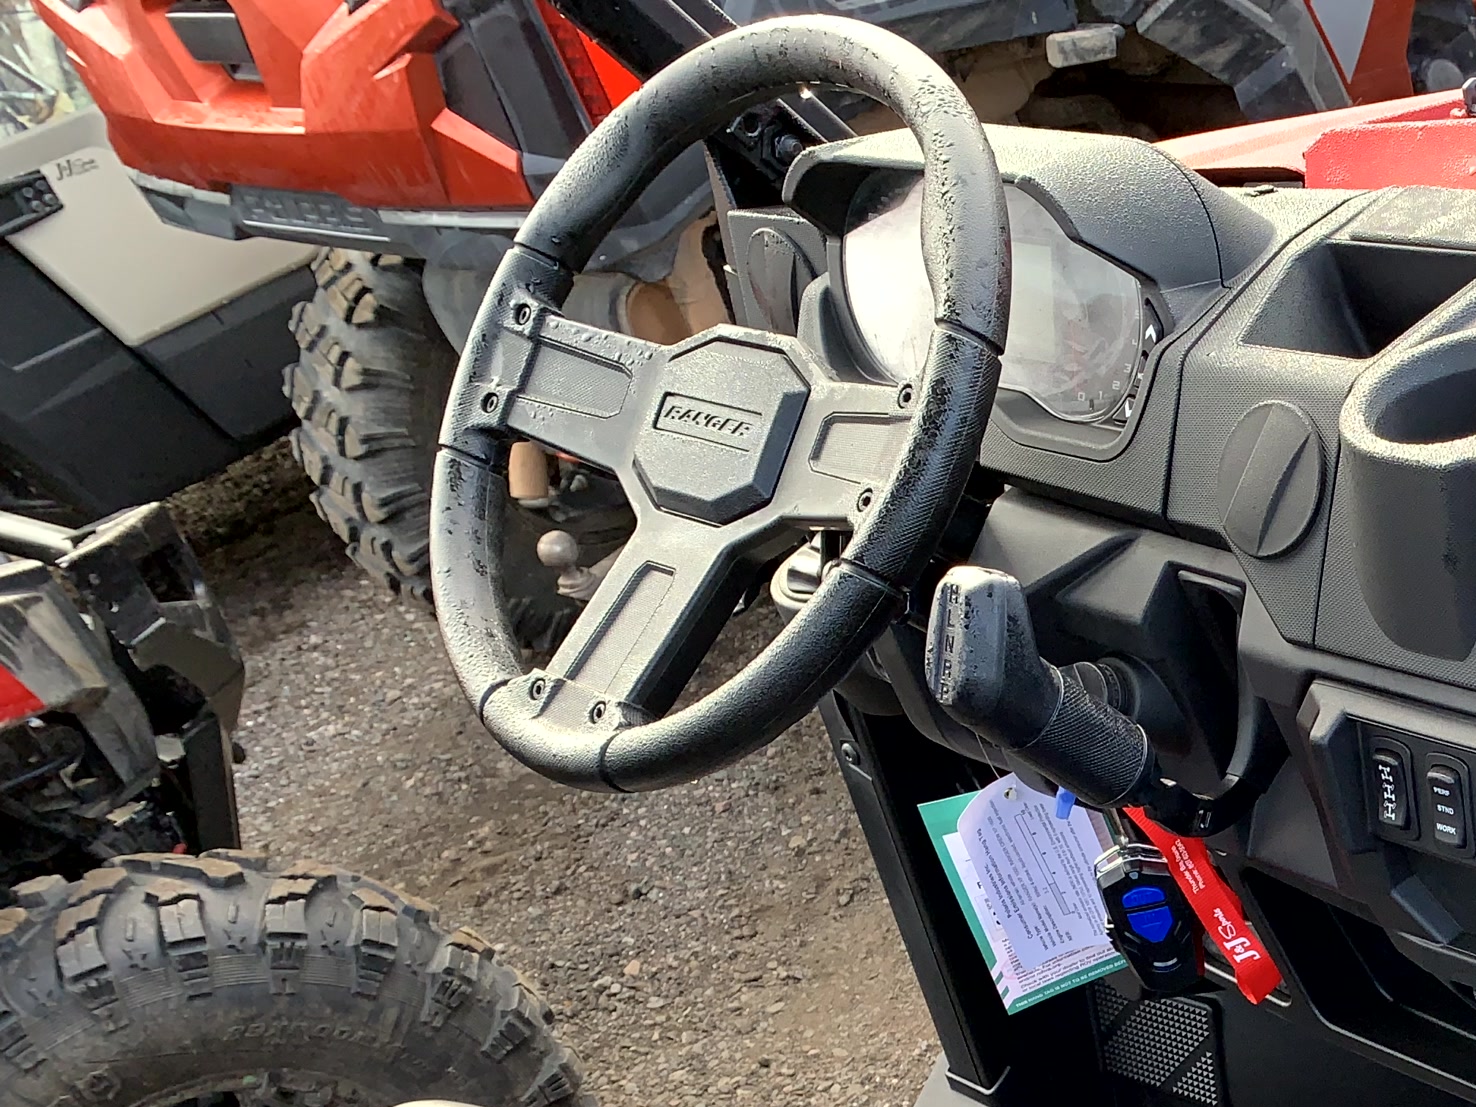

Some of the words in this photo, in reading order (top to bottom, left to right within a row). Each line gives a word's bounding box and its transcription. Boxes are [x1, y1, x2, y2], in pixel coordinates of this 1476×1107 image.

[663, 404, 754, 437] RANGER
[947, 608, 955, 628] L
[944, 634, 955, 653] N
[1436, 804, 1455, 815] STND
[1436, 822, 1456, 835] WORK
[982, 839, 990, 856] Hang
[989, 855, 1005, 886] Information
[1184, 870, 1199, 894] Thunder
[989, 873, 1003, 900] Industries
[1004, 885, 1020, 913] Emissions
[1001, 899, 1012, 918] Polaris
[1017, 913, 1033, 939] Consumer
[1213, 907, 1235, 939] Sports
[1222, 936, 1261, 963] J&J
